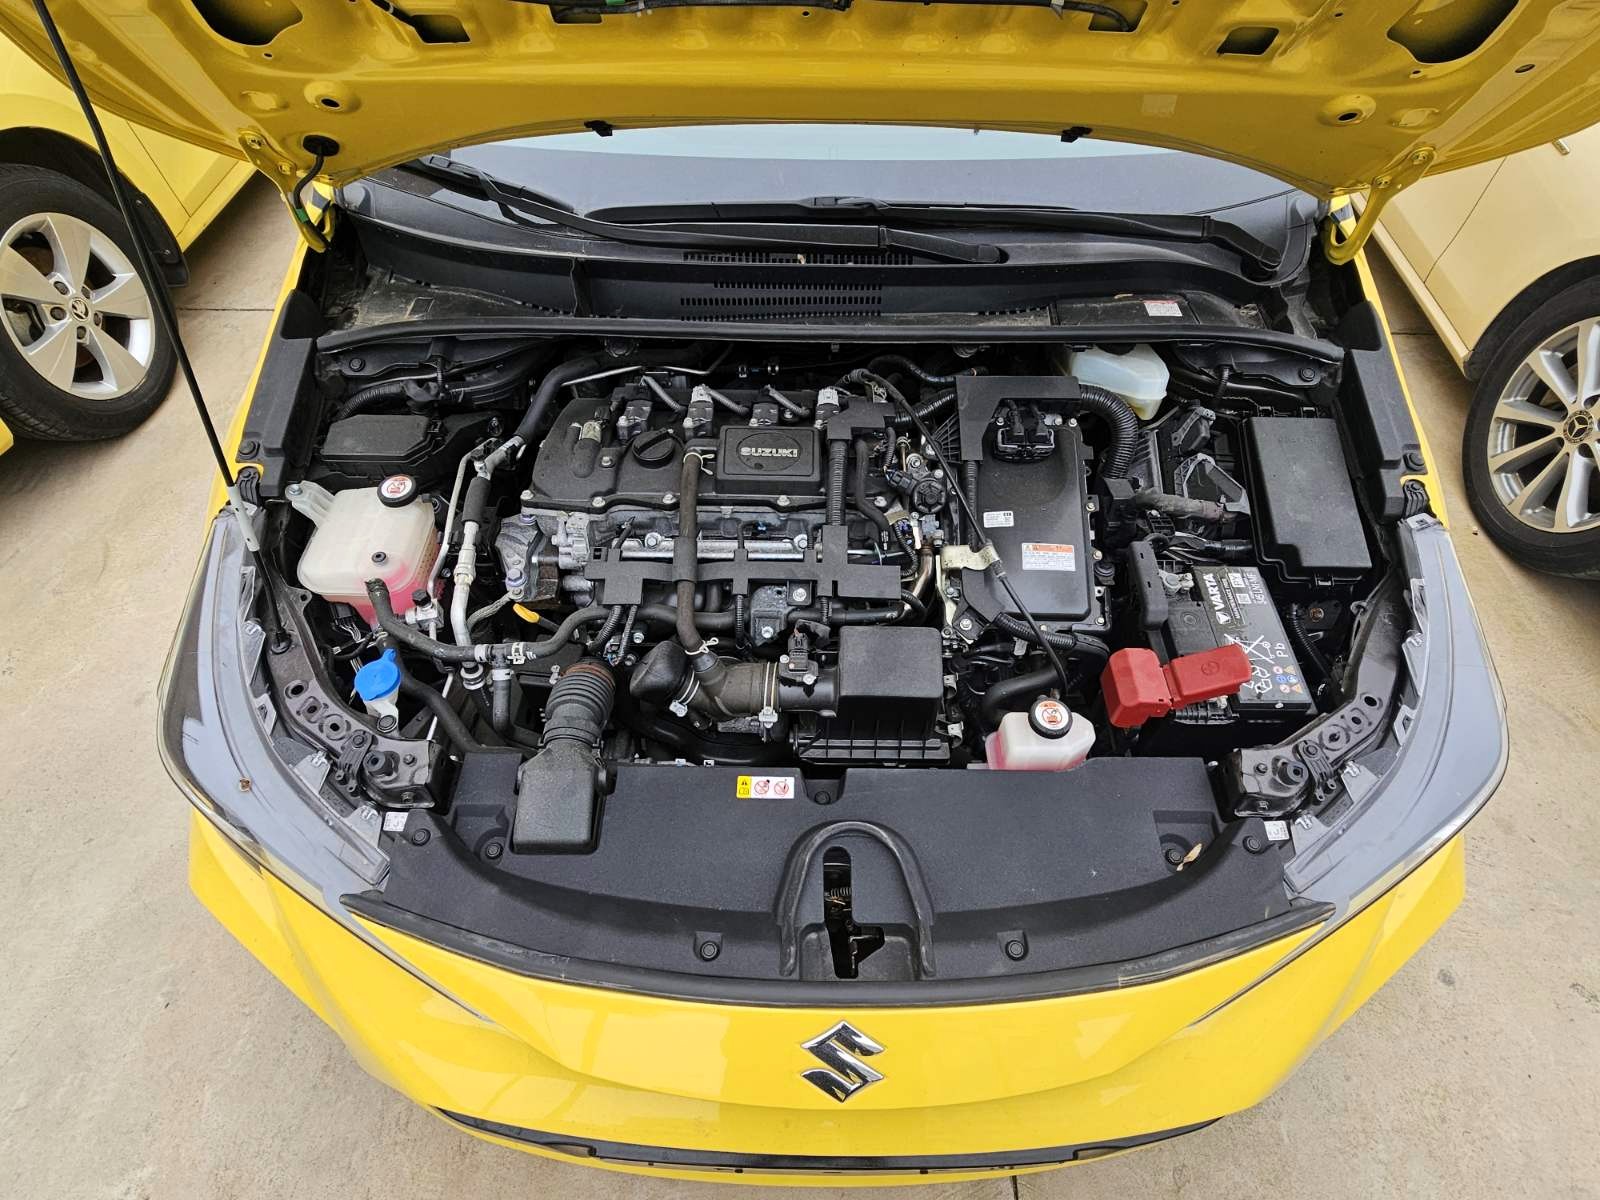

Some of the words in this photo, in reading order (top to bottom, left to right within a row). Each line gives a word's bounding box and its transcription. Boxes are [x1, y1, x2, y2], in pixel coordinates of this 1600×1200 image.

[741, 447, 798, 457] SUZUKI
[1203, 573, 1225, 611] VARTA
[1274, 643, 1288, 657] Pb
